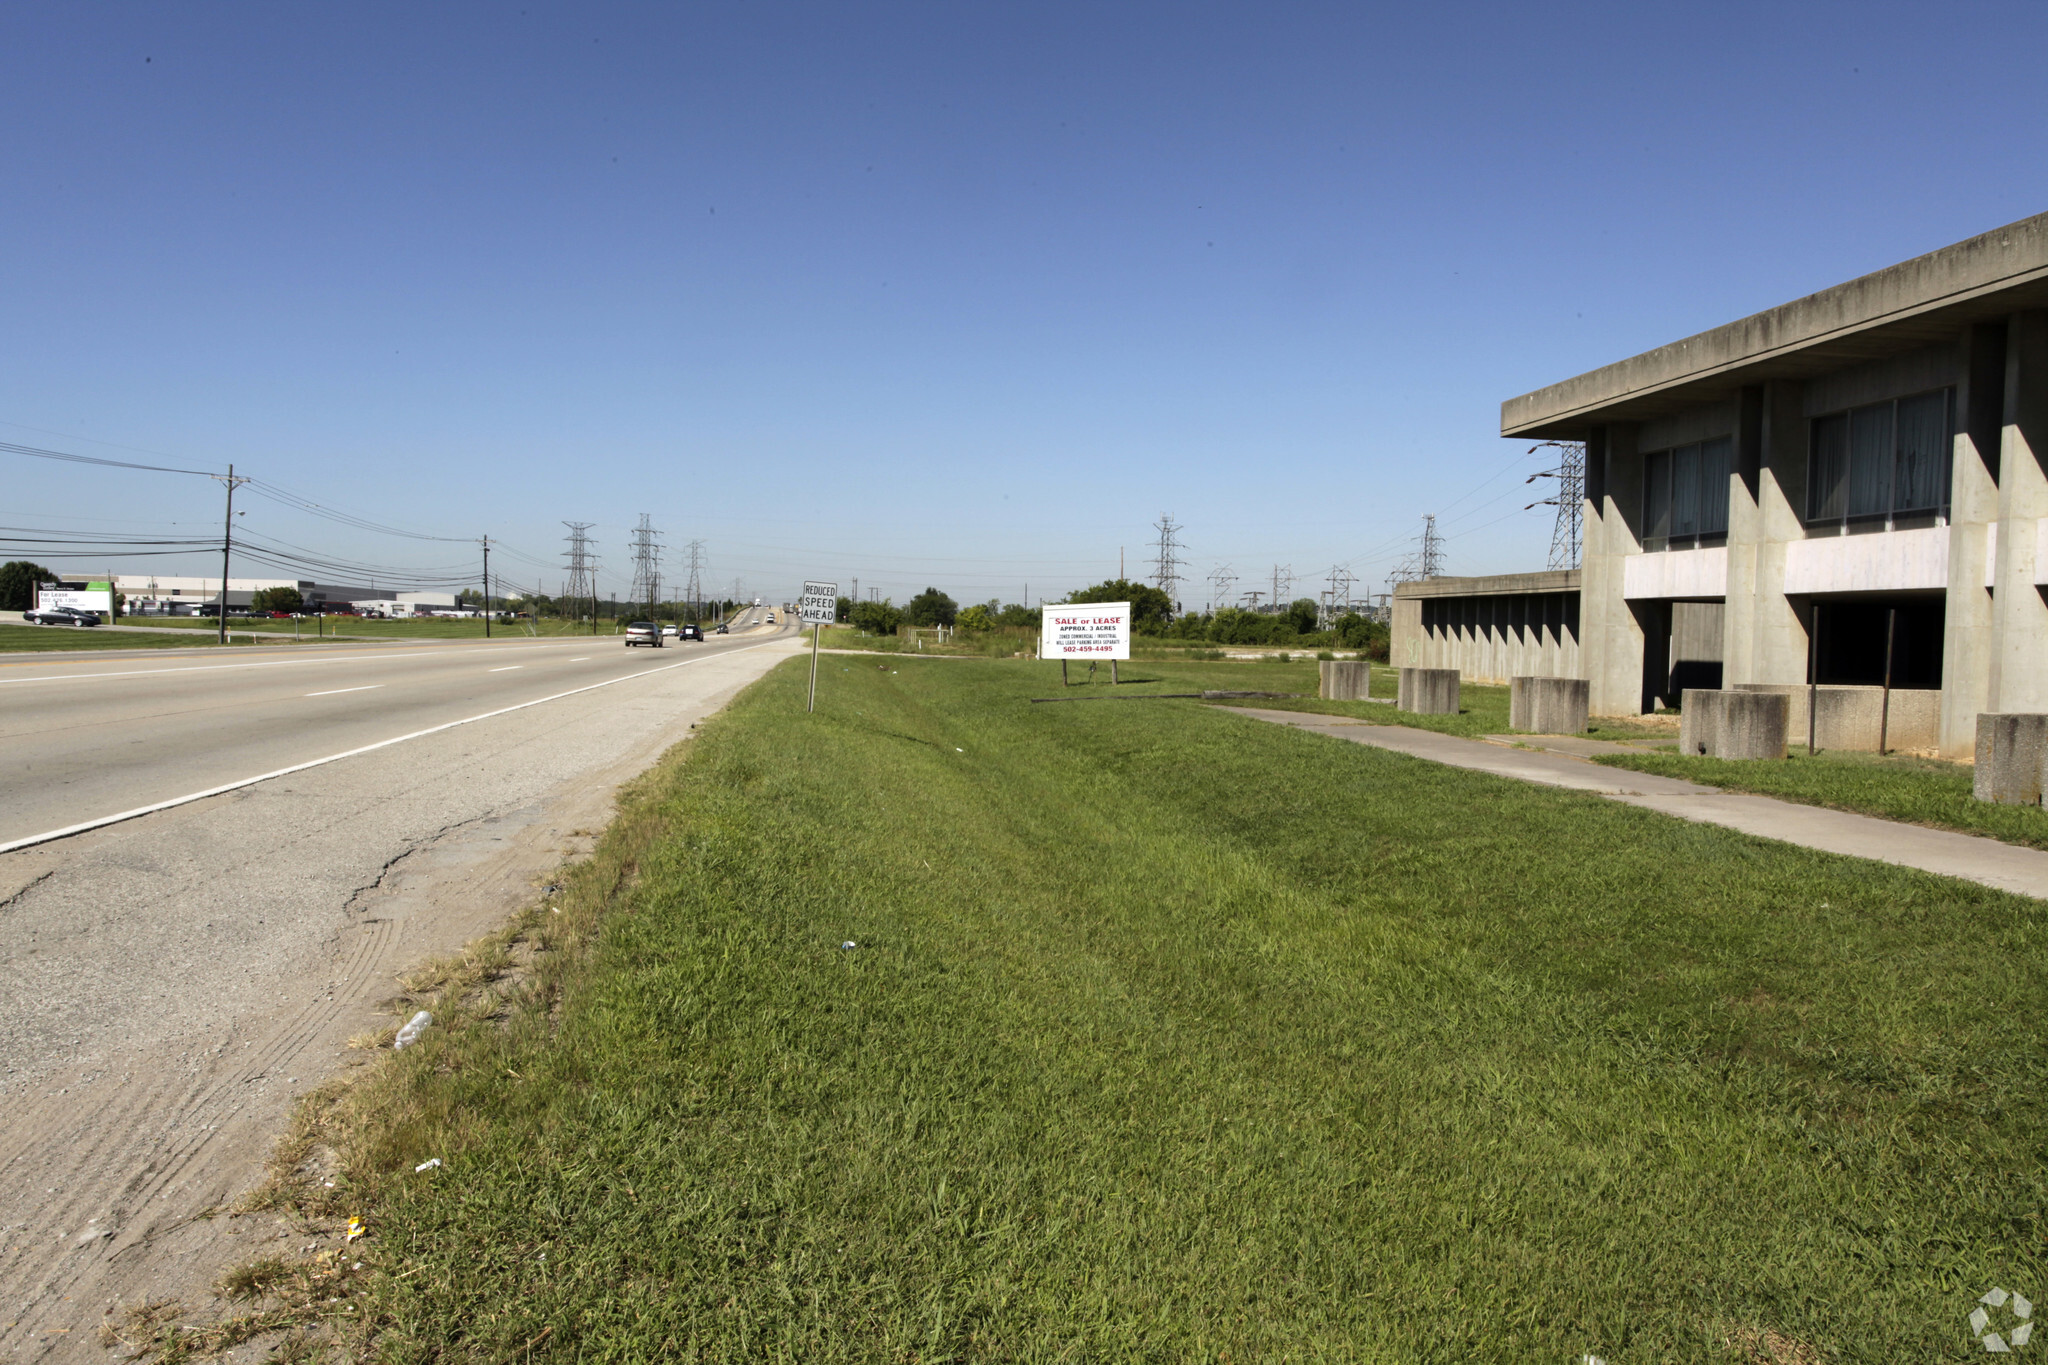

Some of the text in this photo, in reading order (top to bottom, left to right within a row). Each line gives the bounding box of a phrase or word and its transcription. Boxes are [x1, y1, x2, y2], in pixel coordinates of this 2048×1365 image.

[806, 585, 835, 596] REDUCED
[805, 597, 834, 608] SPEED
[804, 609, 833, 620] AHEAD
